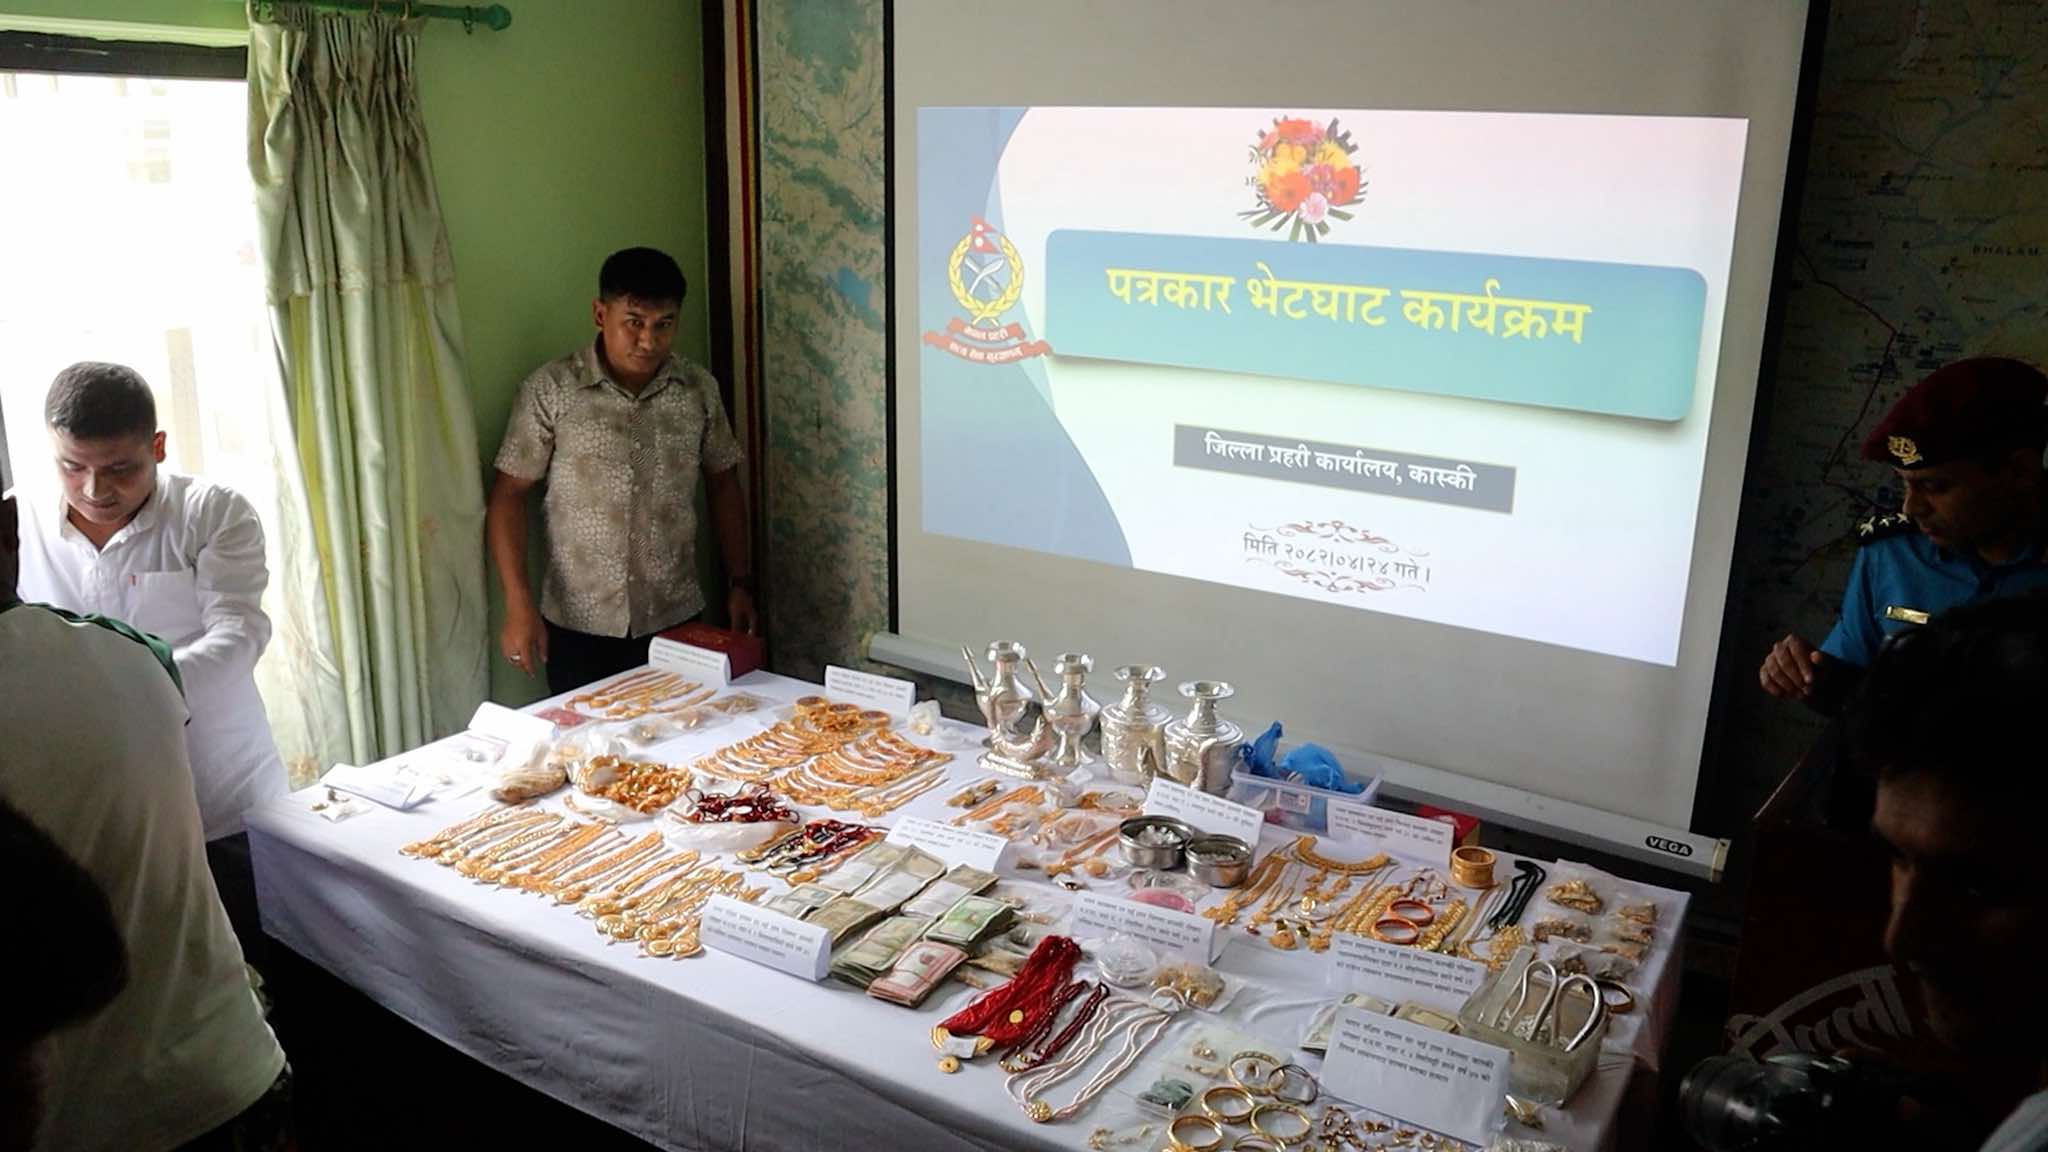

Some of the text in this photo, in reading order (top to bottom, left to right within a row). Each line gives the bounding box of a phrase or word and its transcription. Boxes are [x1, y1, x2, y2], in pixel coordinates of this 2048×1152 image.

[1105, 261, 1592, 344] पत्रकार भेटघाट कार्यक्रम
[1204, 431, 1477, 492] जिल्ला प्रहरी कार्यालय, कास्की
[1243, 532, 1278, 556] मिति
[1393, 559, 1420, 581] गते
[1649, 837, 1690, 855] VEGA
